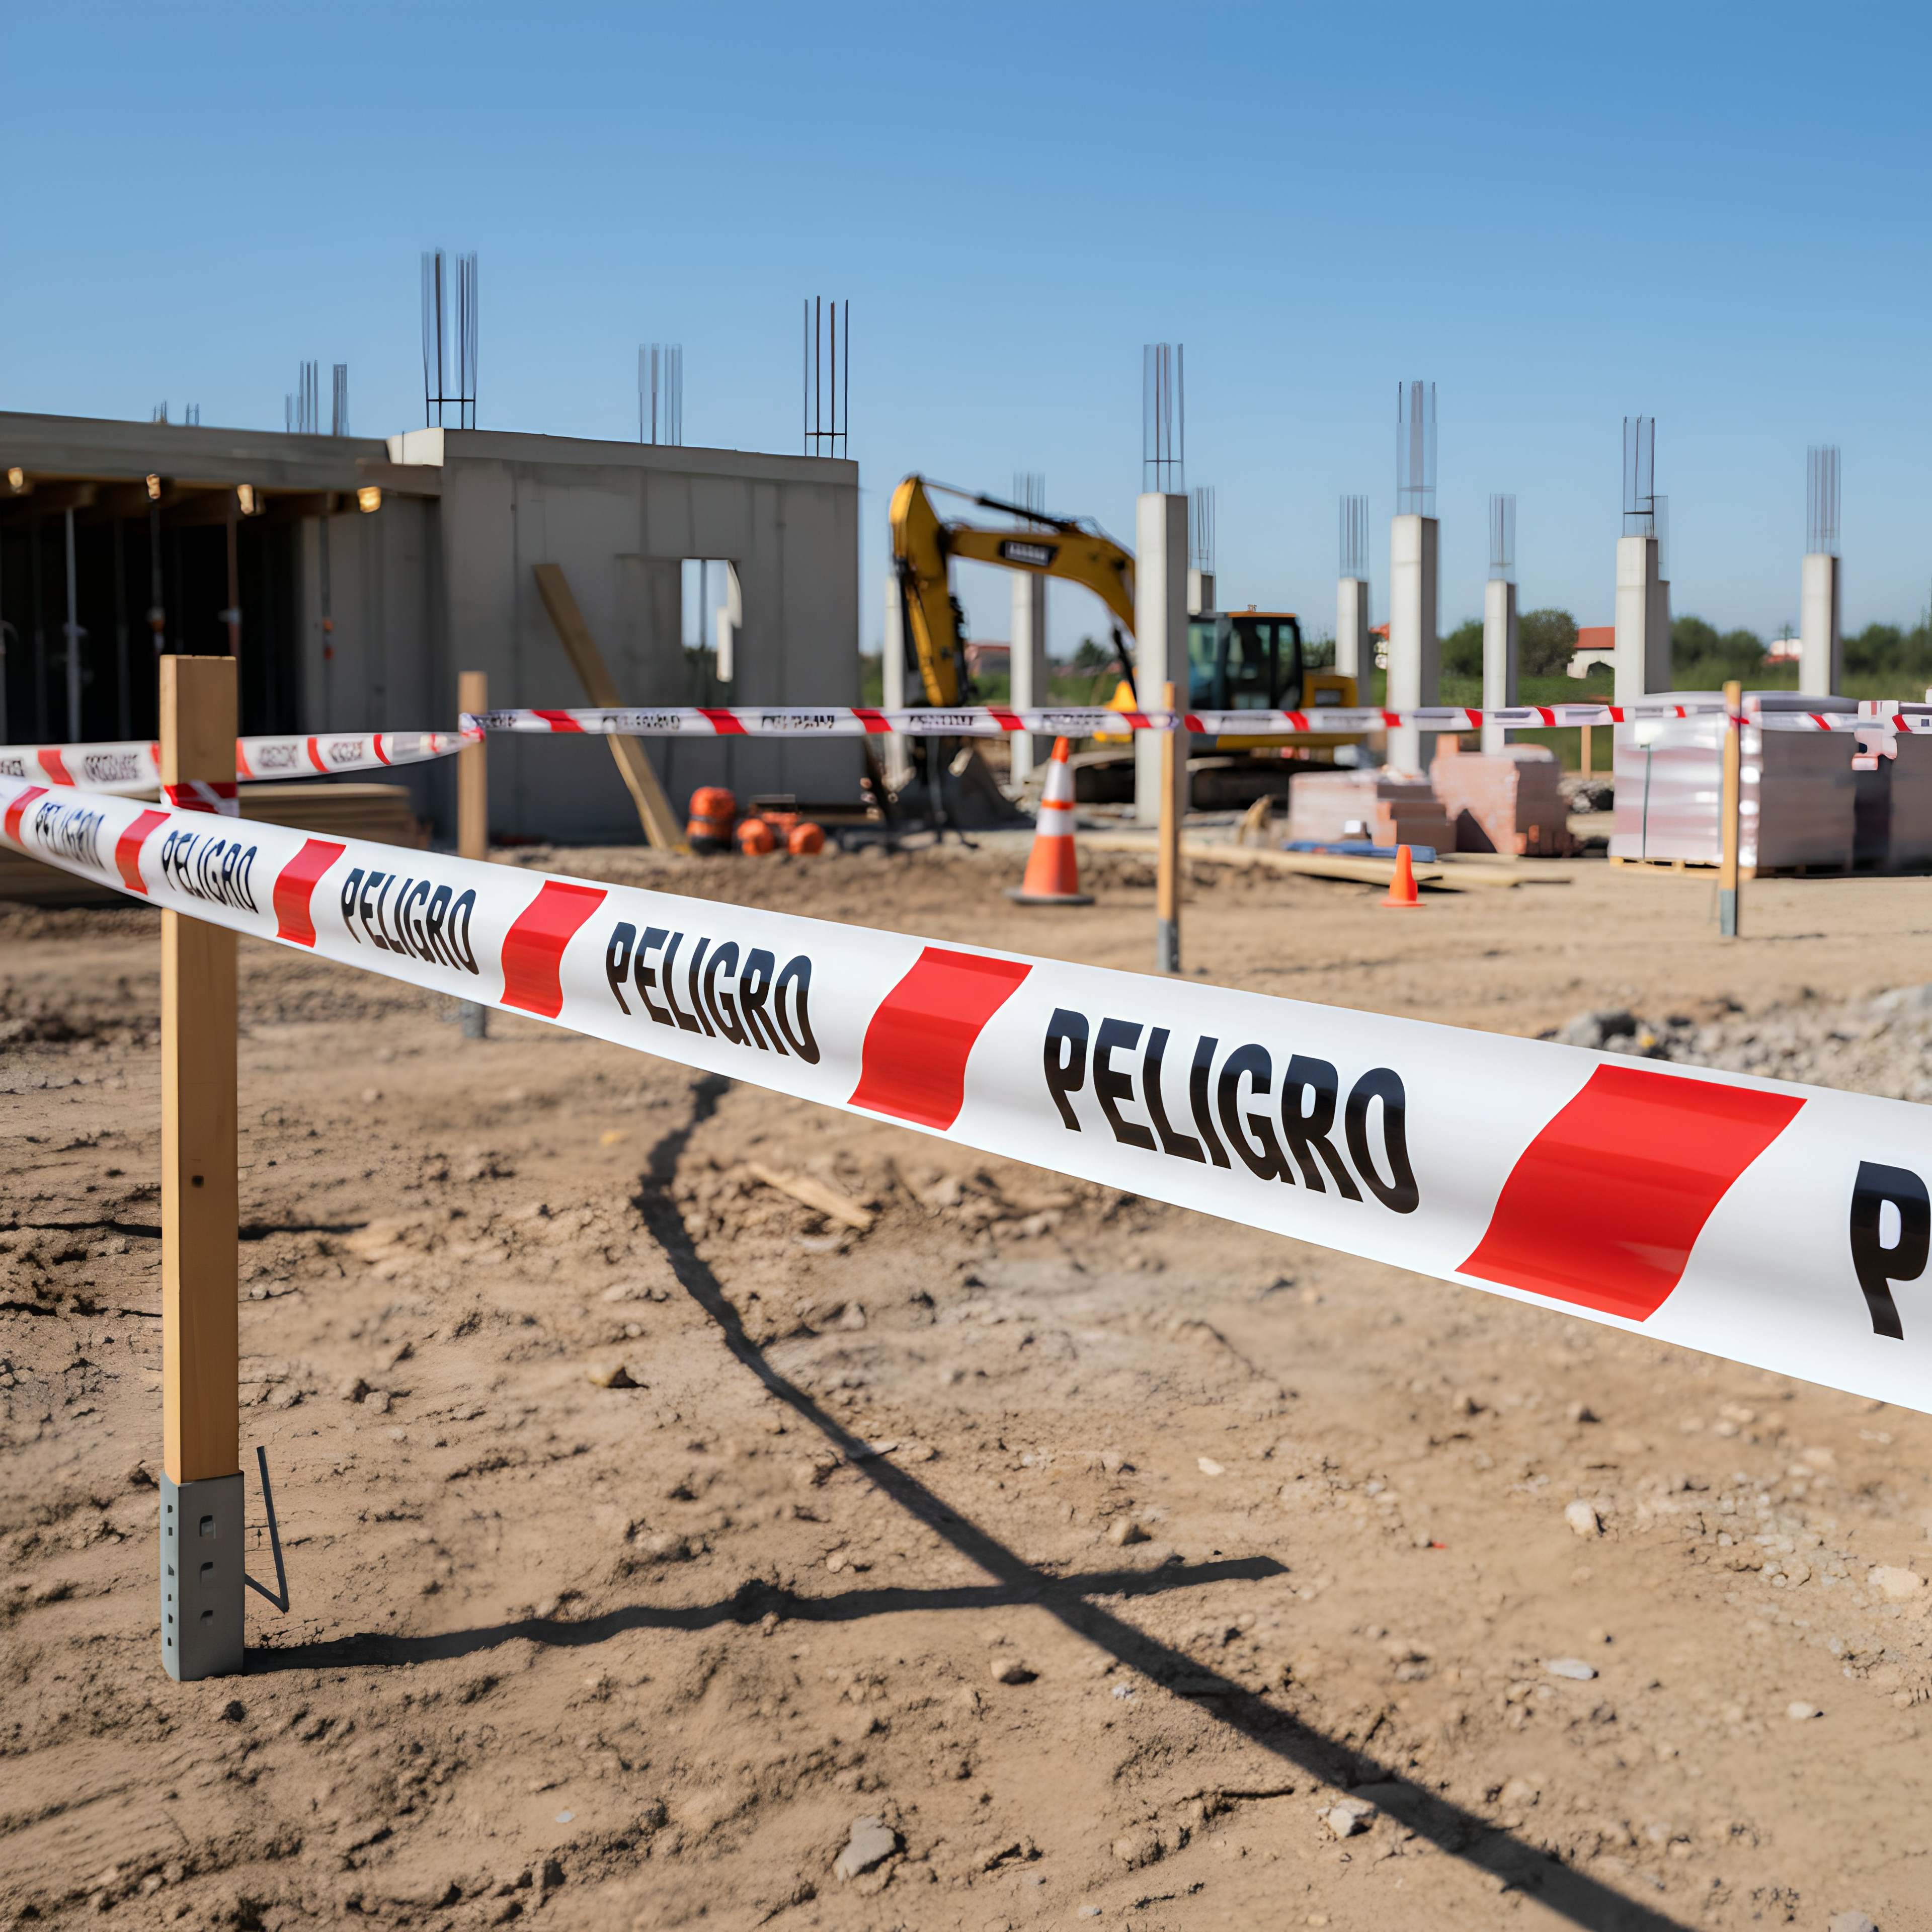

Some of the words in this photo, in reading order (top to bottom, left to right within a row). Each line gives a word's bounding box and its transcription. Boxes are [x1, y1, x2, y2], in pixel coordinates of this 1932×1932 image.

[342, 868, 479, 975] PELIGRO
[606, 922, 820, 1065] PELIGRO
[1043, 1008, 1419, 1214] PELIGRO
